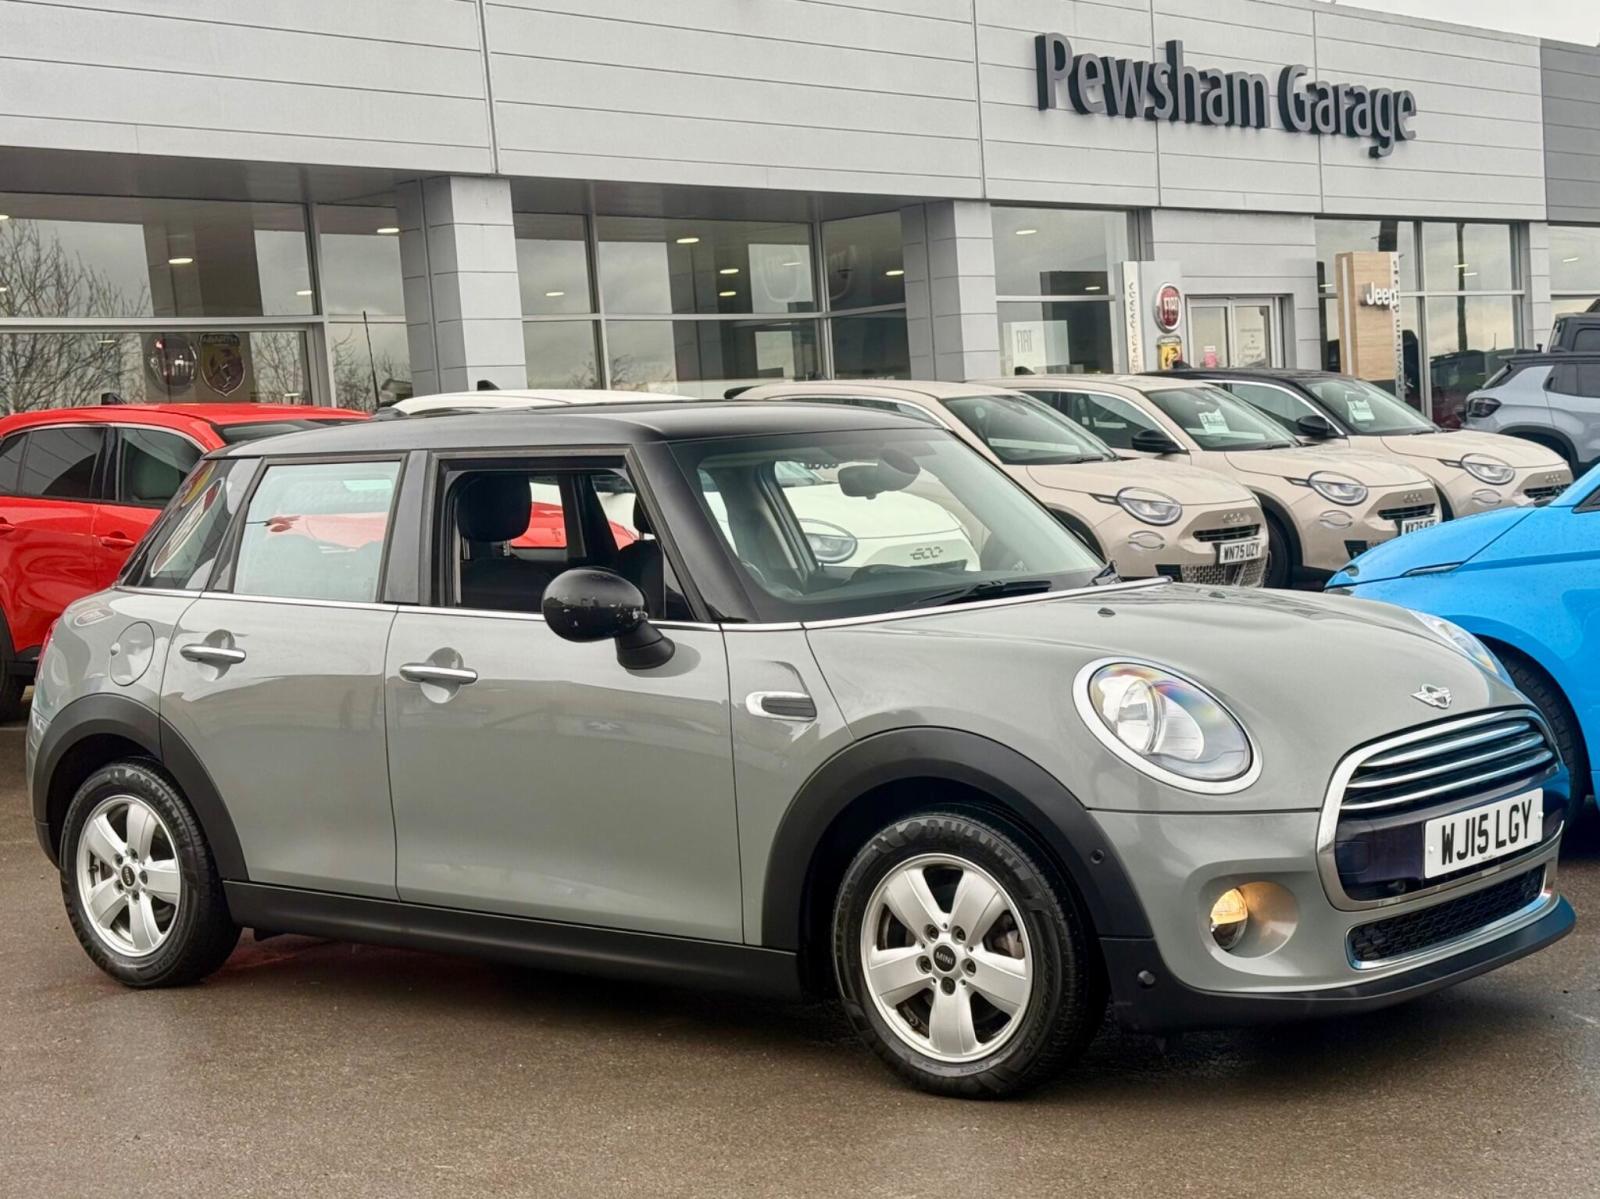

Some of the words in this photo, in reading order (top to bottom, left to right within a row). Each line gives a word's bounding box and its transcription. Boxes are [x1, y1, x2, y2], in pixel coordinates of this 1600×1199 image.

[1035, 32, 1271, 128] Pewsham
[1278, 64, 1416, 158] Garage
[1366, 281, 1398, 310] Jeep
[1016, 329, 1032, 353] FIAT
[1224, 544, 1245, 561] WN75
[1442, 822, 1489, 866] WJ15
[1495, 799, 1532, 849] LGY
[936, 951, 953, 965] MINI
